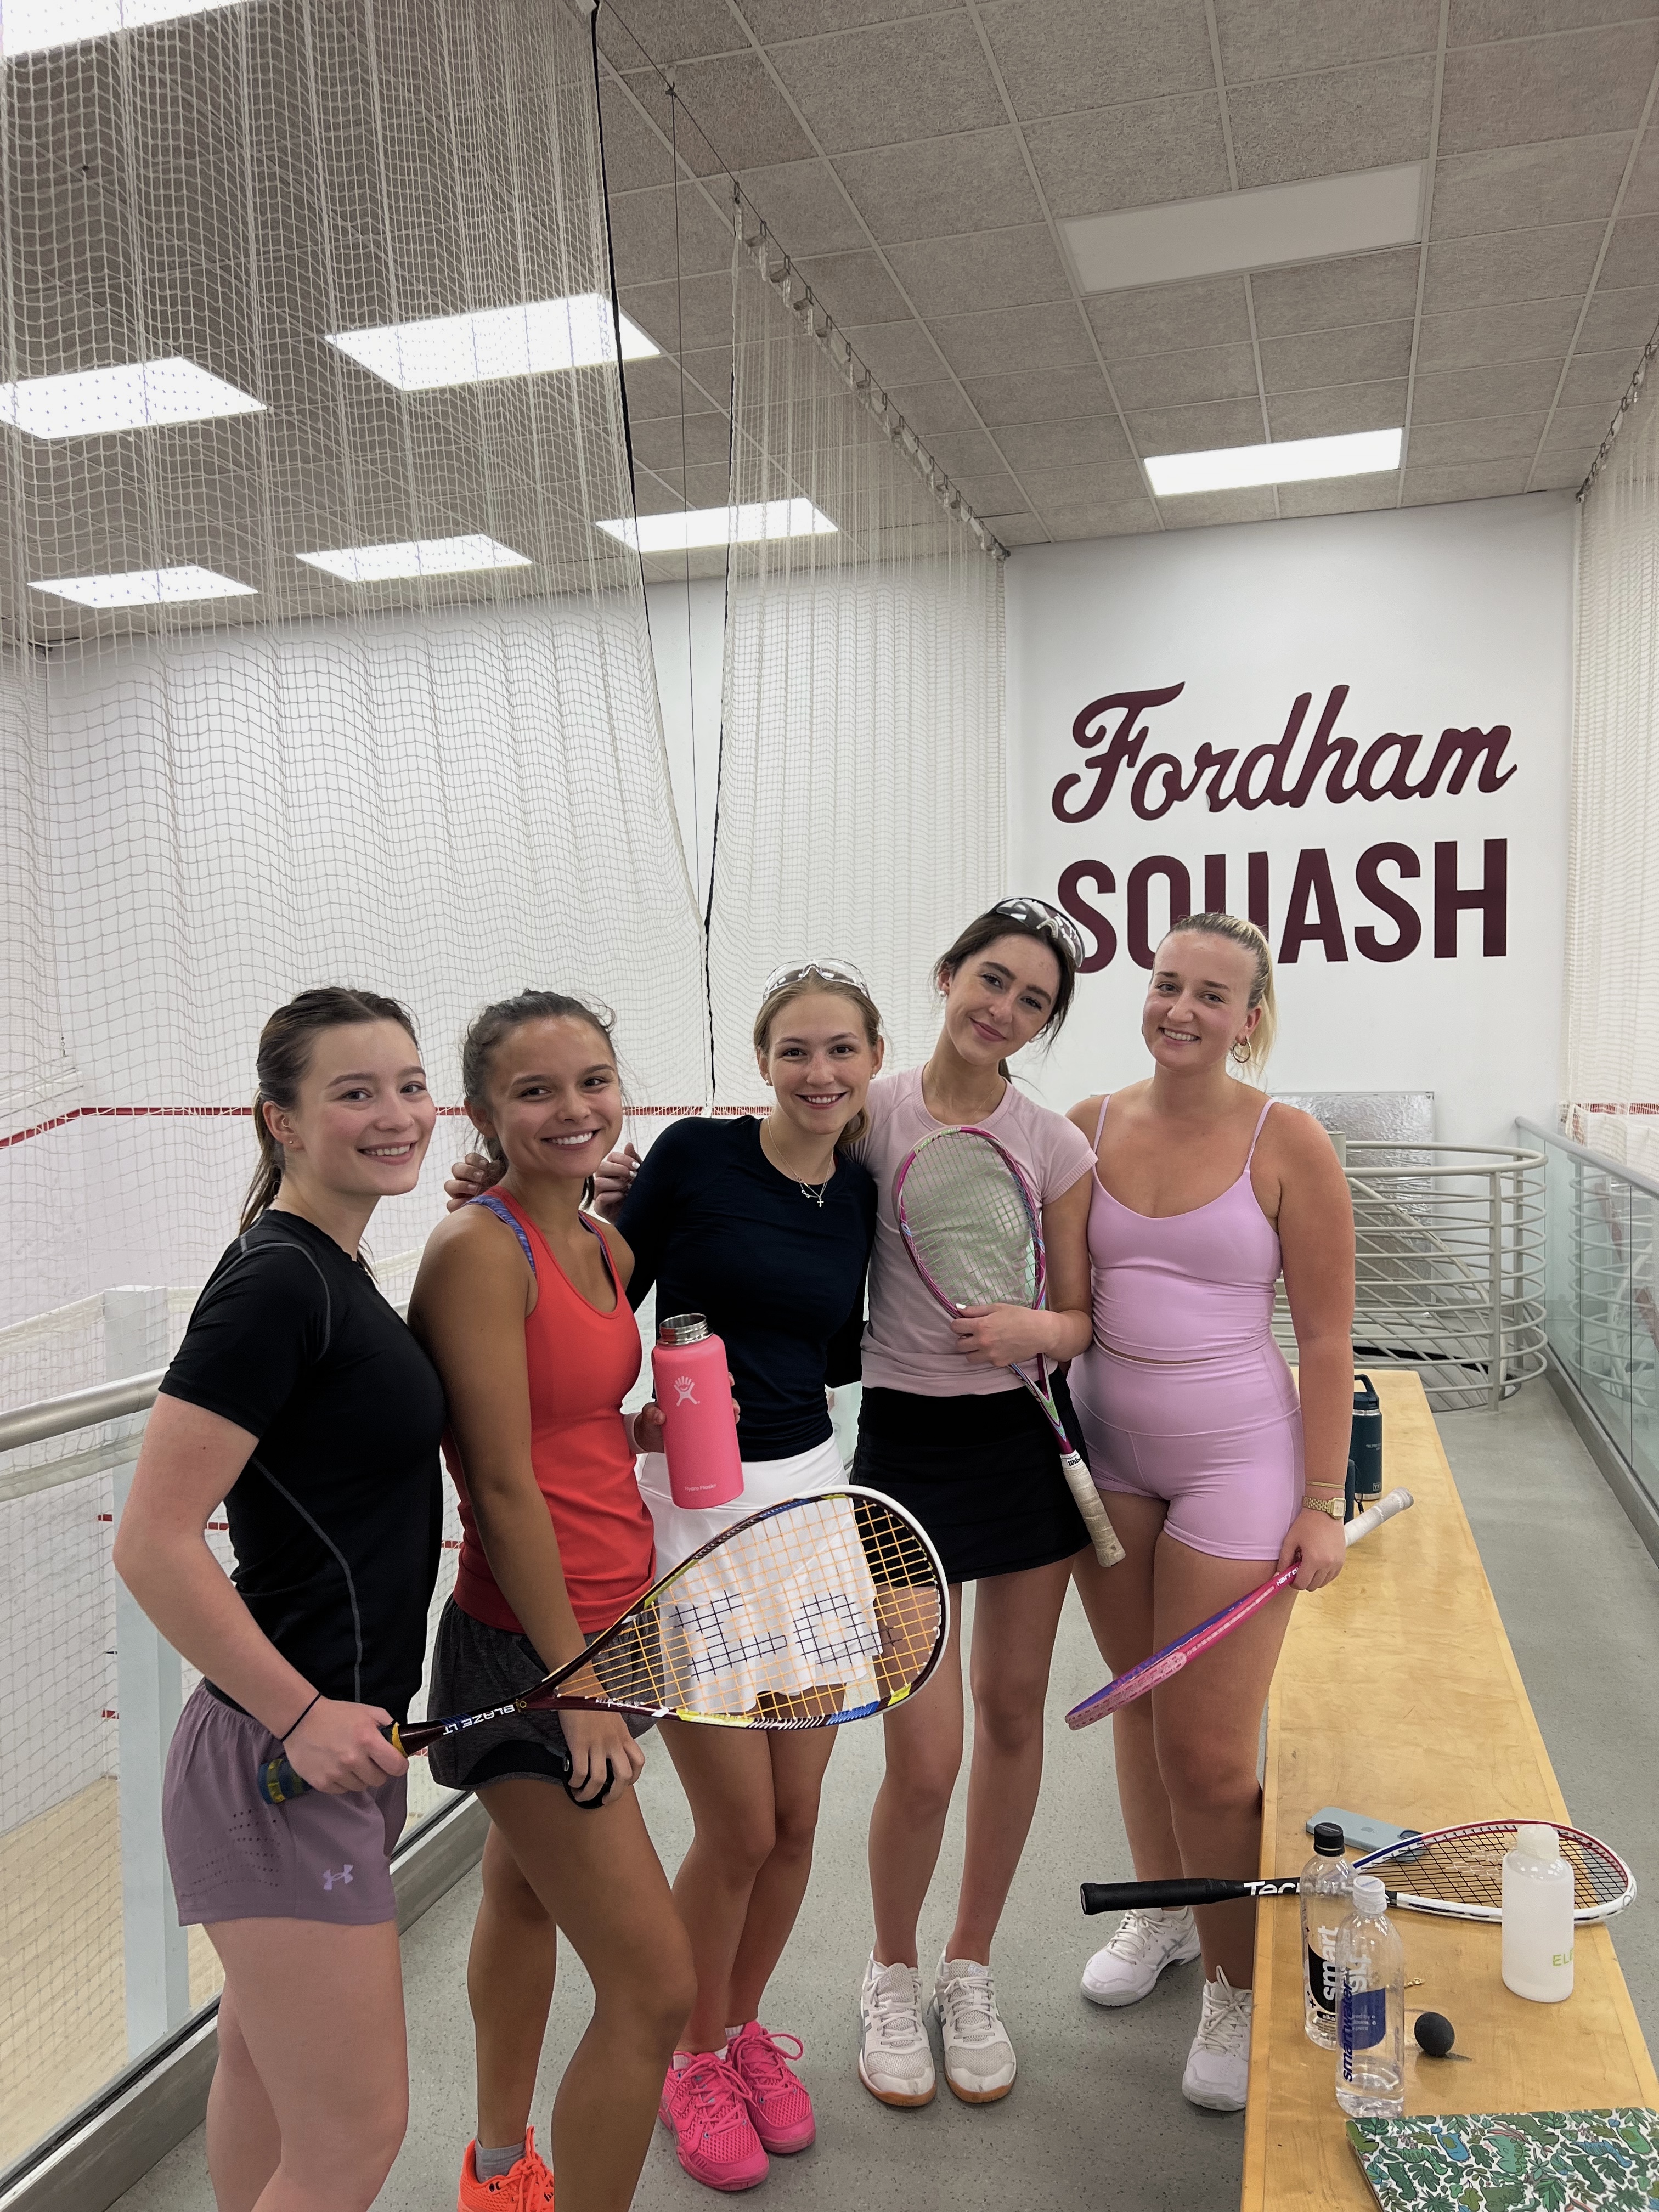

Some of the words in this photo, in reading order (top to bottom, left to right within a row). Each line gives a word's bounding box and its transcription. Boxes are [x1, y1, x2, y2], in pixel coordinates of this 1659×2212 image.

[1052, 681, 1517, 824] Fordham
[1057, 838, 1508, 974] SQUASH
[442, 1723, 458, 1736] LT
[460, 1703, 515, 1728] BLAZE
[1343, 1978, 1354, 2083] smartwater
